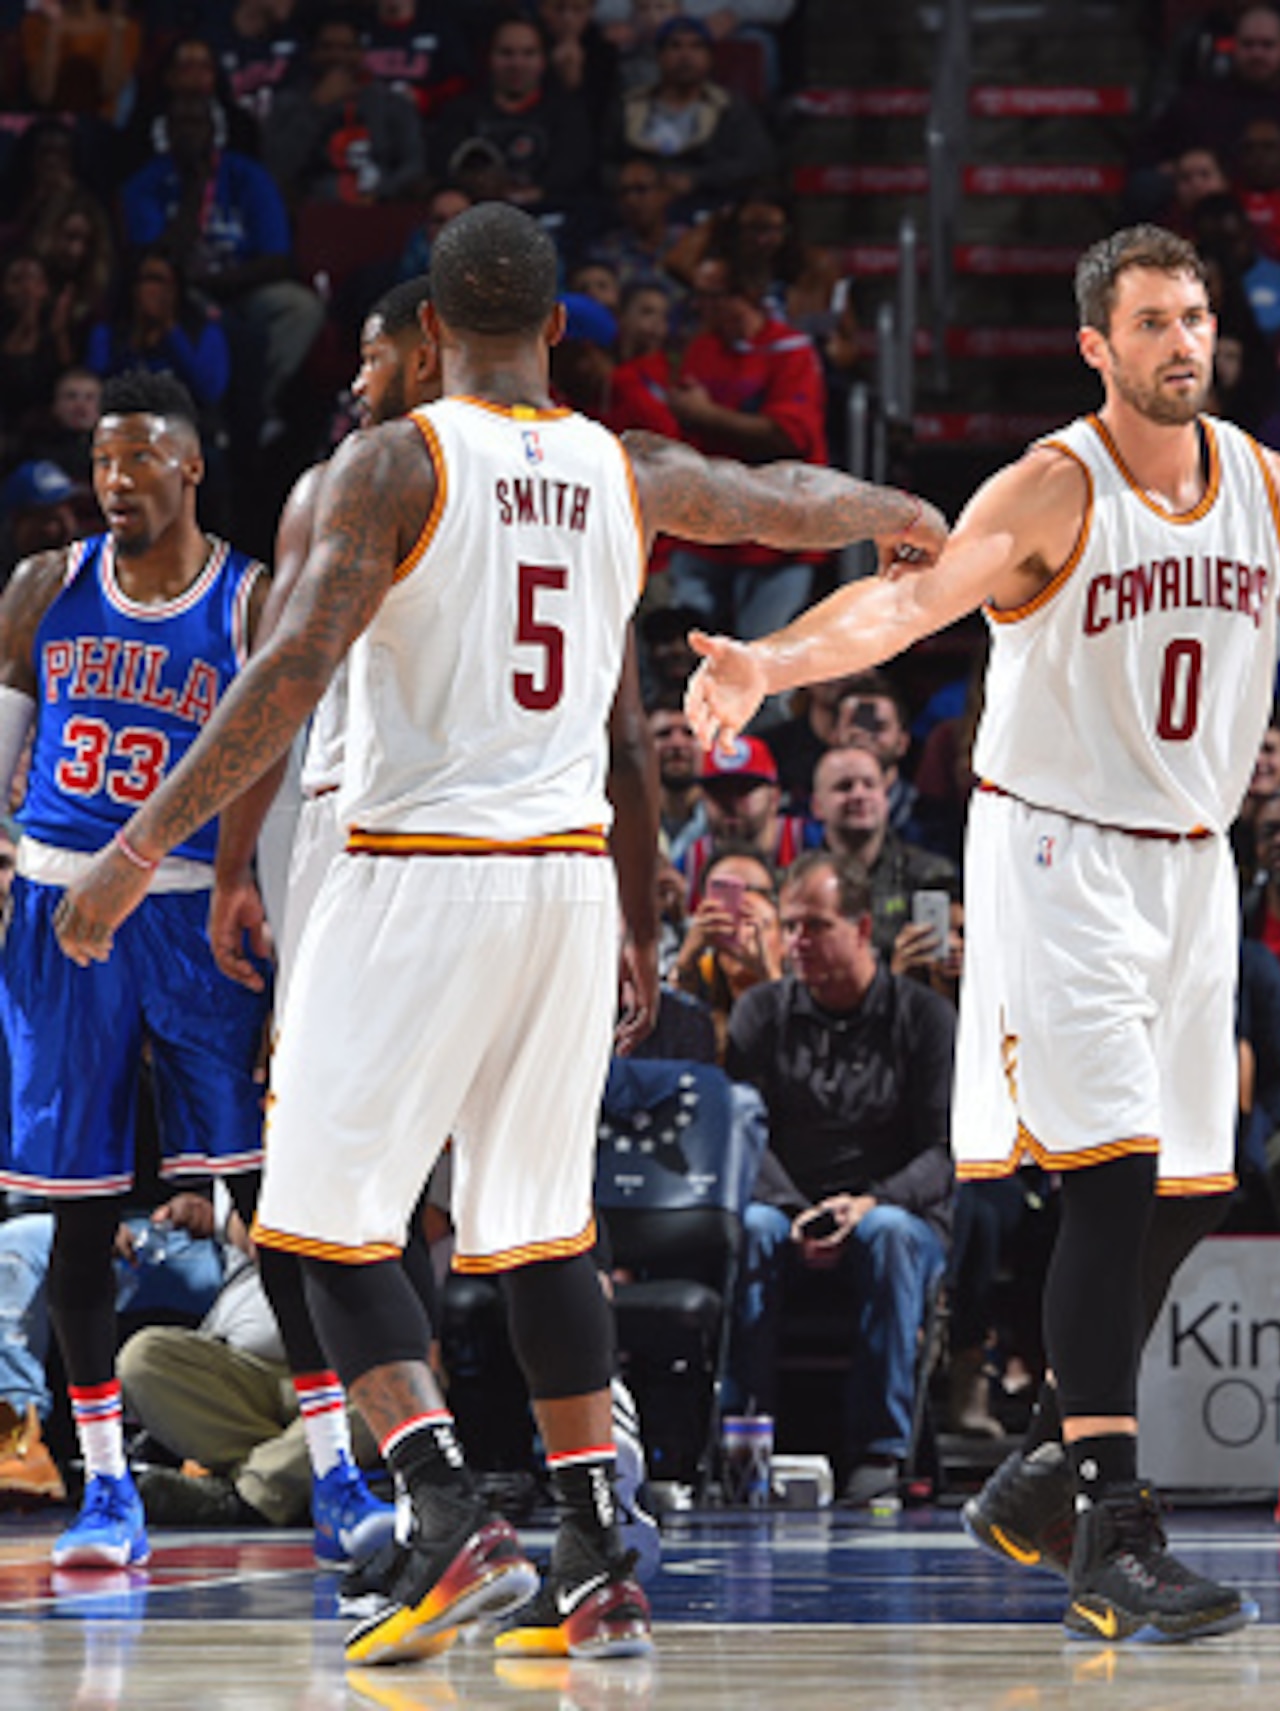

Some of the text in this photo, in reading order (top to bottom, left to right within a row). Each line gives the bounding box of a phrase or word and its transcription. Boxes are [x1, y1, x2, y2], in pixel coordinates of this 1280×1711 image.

[496, 478, 590, 533] SMITH
[42, 637, 218, 725] PHILA
[512, 562, 569, 712] 5
[1157, 638, 1202, 741] 0
[56, 715, 169, 804] 33
